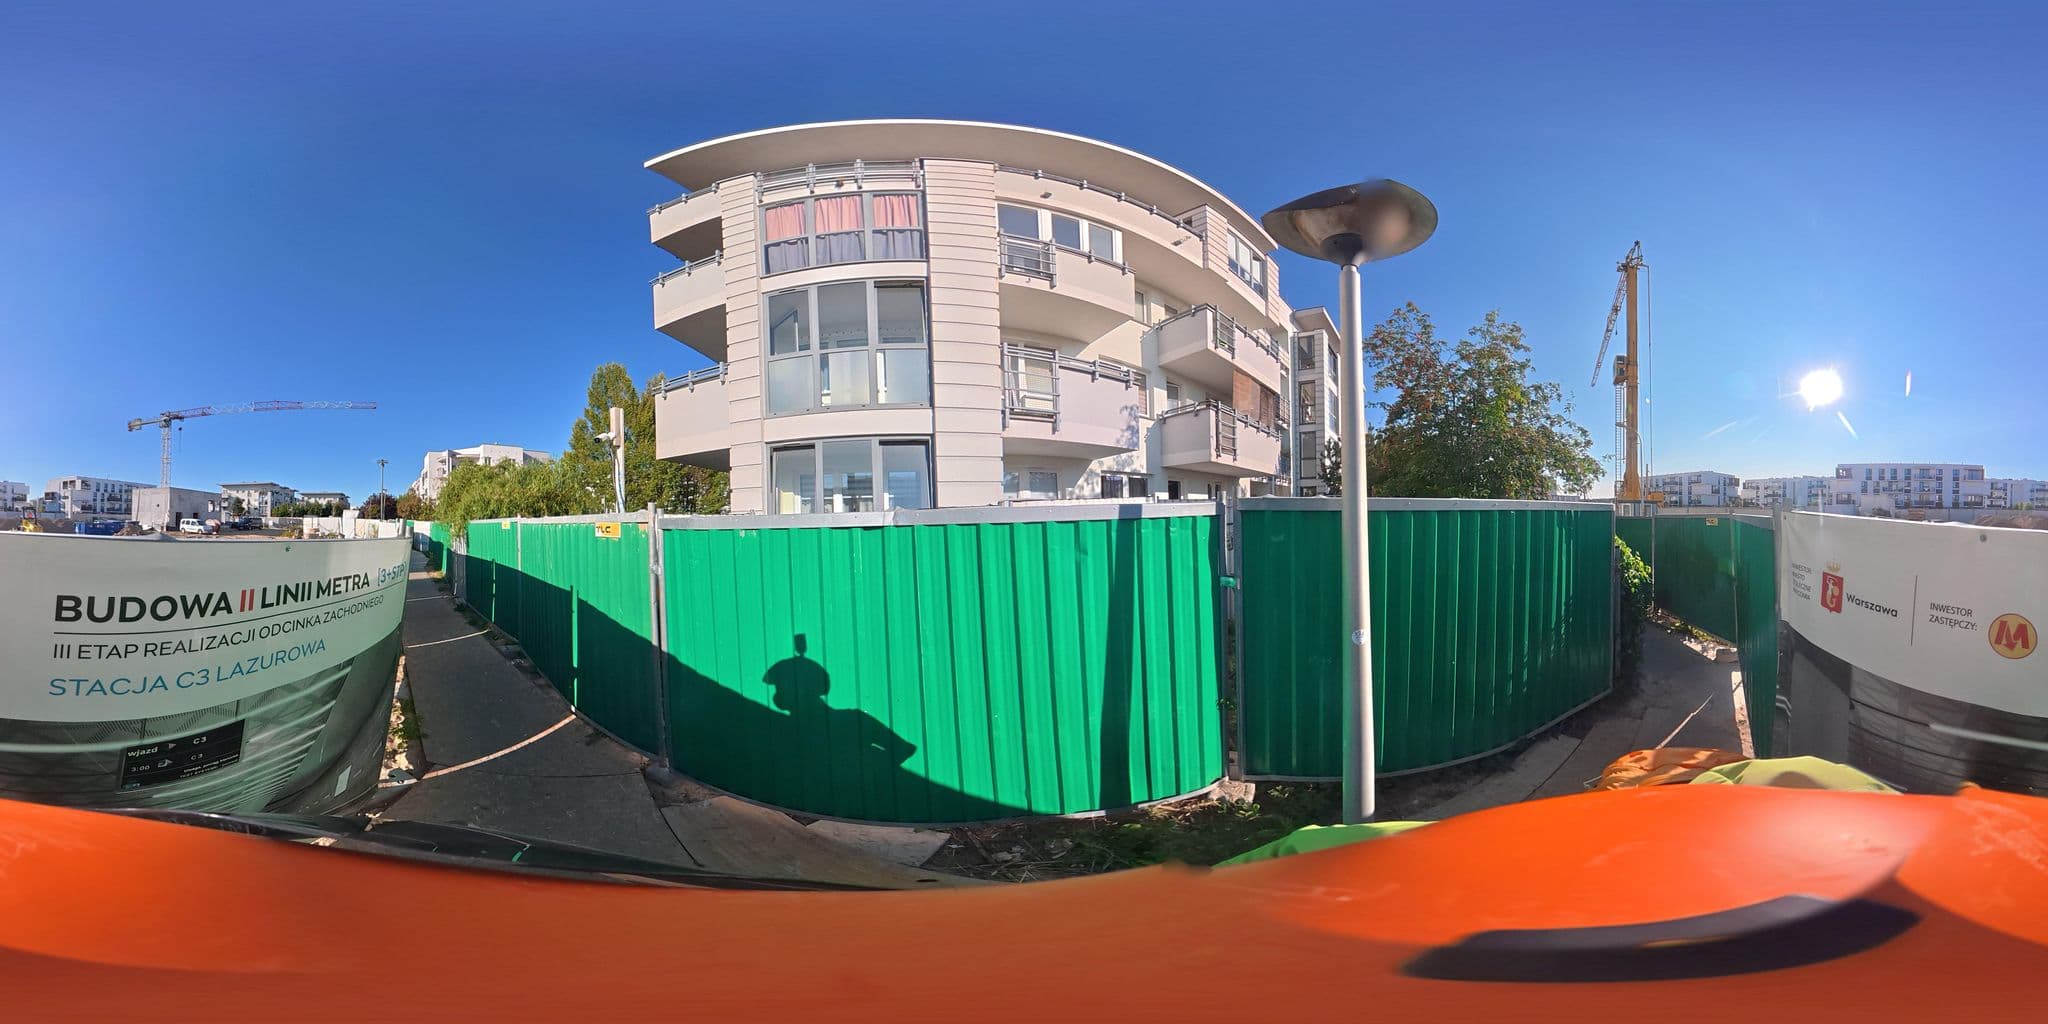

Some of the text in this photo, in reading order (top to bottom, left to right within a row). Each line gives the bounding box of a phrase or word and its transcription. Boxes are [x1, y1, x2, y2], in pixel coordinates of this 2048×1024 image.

[55, 592, 232, 623] BUDOWA
[240, 588, 255, 613] II
[260, 582, 312, 609] LINII
[316, 572, 370, 599] METRA
[1846, 592, 1898, 618] Warszawa
[1930, 602, 1973, 618] INWESTOR
[53, 594, 384, 659] III ETAP REALIZACJI ODCINKA ZACHODNIEGO
[1929, 614, 1978, 632] ZASTĘPCZY:
[49, 639, 326, 696] STACJA C3 LAZUROWA
[127, 746, 158, 757] wjazd
